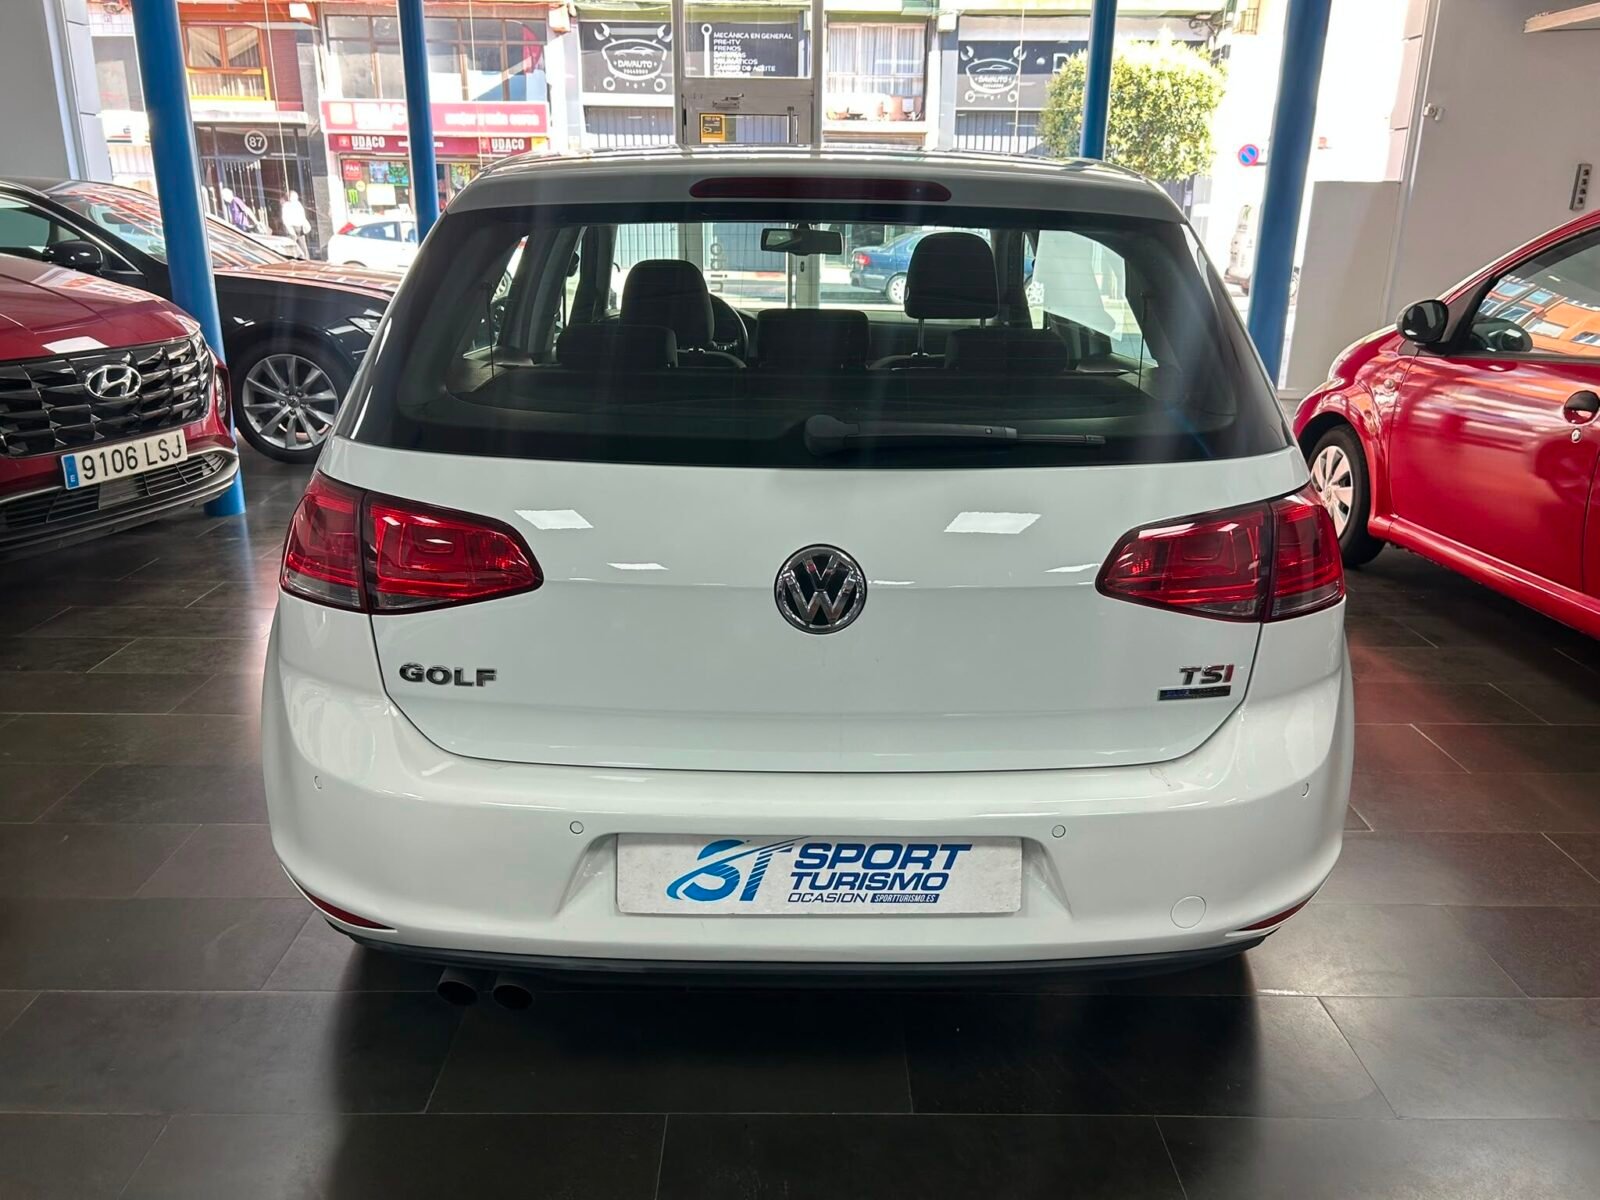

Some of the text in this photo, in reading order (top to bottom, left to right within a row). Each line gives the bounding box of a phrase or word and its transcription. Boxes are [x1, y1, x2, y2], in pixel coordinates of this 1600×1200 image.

[714, 31, 749, 39] MECÁNICA
[618, 60, 652, 68] DAVAUTO
[249, 136, 263, 147] 87
[351, 135, 385, 148] UDACO
[491, 138, 525, 150] UDACO
[82, 446, 138, 480] 9106
[144, 435, 182, 467] LSJ
[399, 662, 497, 687] GOLF
[1179, 664, 1235, 686] TSI
[794, 843, 973, 870] SPORT
[790, 871, 950, 891] TURISMO
[787, 892, 937, 903] OCASION SPORTTURISMO.ES
